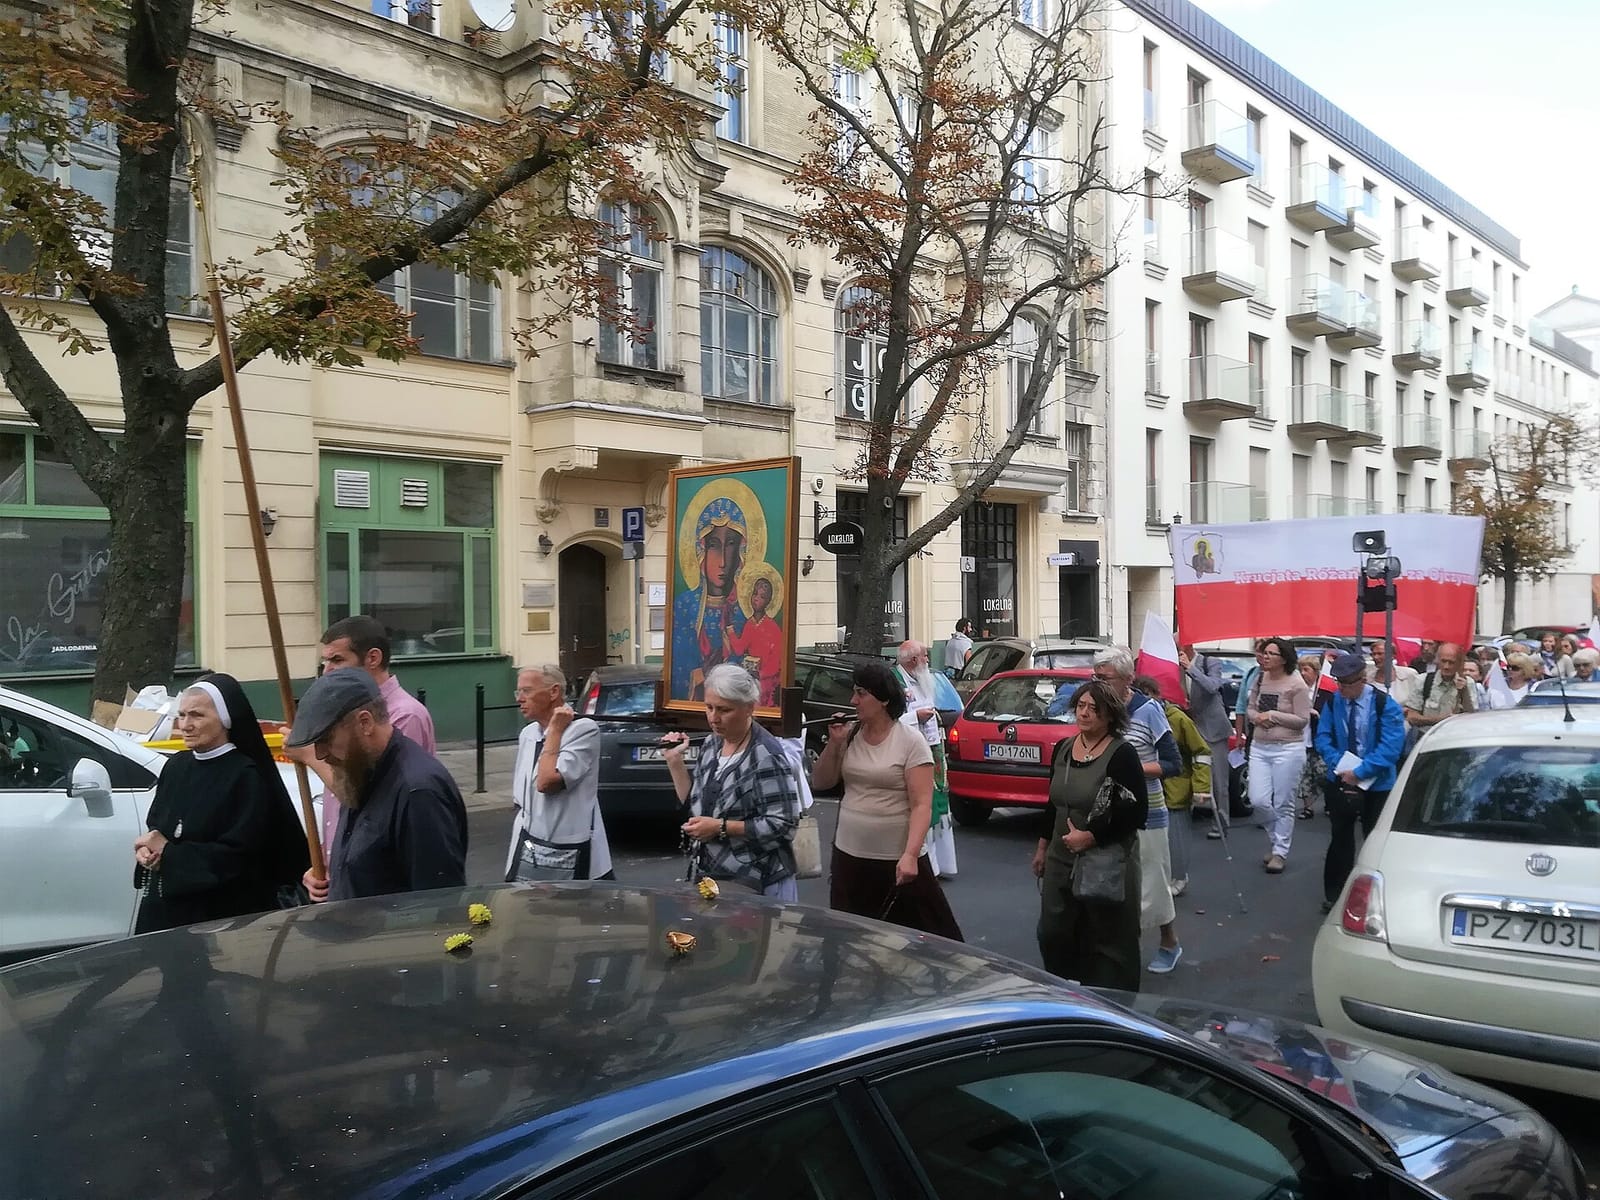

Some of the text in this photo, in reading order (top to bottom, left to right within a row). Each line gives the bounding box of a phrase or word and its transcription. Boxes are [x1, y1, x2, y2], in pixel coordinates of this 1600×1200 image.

[626, 511, 640, 538] P
[1234, 569, 1300, 585] Krucjata
[1406, 570, 1425, 580] za
[639, 747, 657, 760] PZ
[990, 745, 1038, 759] PO 176NL
[1470, 913, 1600, 951] PZ 703L
